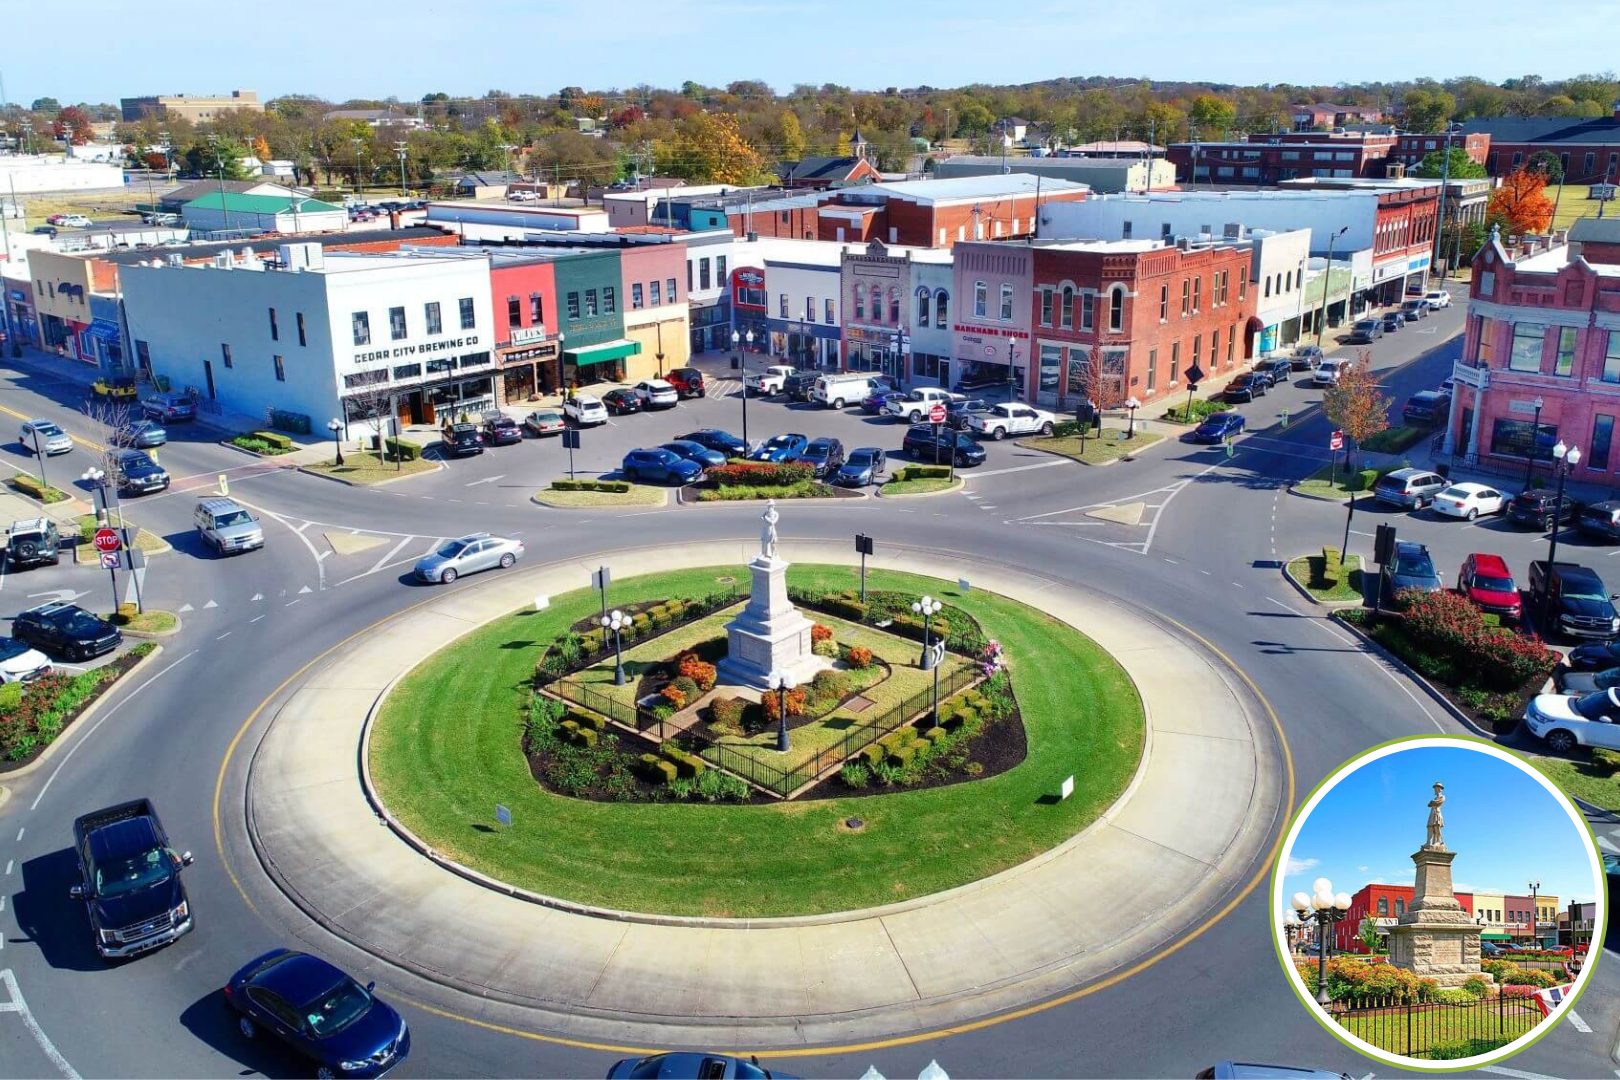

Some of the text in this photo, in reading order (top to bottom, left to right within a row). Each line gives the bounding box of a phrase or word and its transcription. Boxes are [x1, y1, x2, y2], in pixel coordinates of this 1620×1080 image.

[1002, 330, 1029, 339] SHOES
[354, 336, 479, 363] CEDAR CITY BREWING CO
[96, 535, 118, 546] STOP
